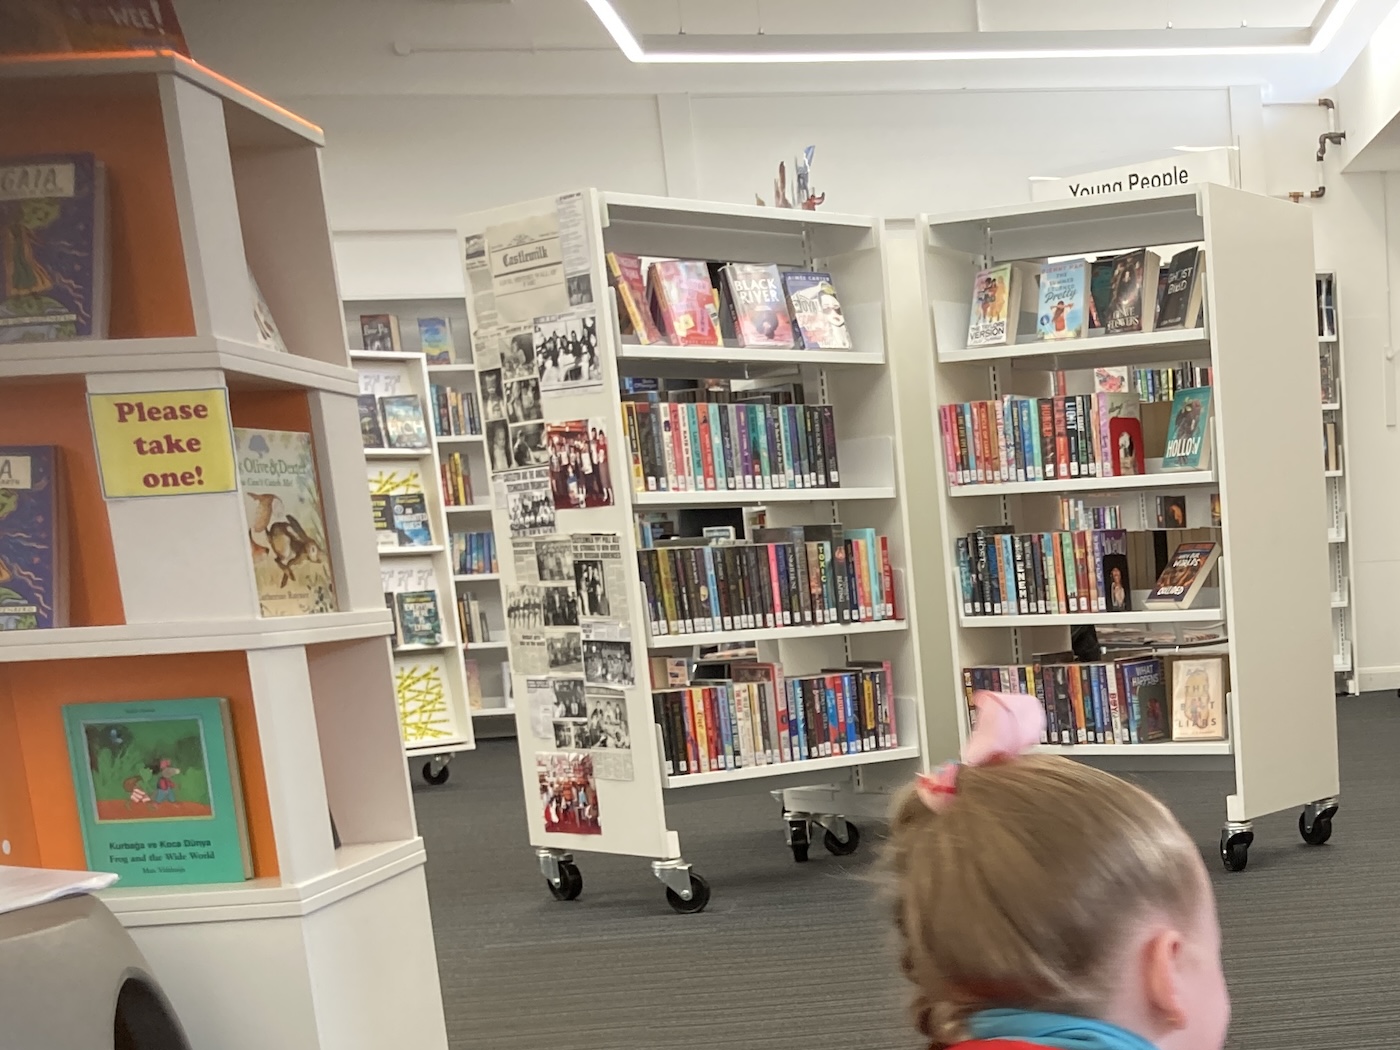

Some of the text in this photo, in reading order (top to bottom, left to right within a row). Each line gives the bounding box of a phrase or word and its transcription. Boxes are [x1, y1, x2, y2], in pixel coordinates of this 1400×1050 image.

[734, 278, 777, 292] BLACK
[740, 290, 779, 304] RIVER
[113, 401, 208, 423] Please
[1065, 402, 1078, 431] LIGHT
[133, 434, 201, 456] take
[142, 466, 205, 488] one!
[818, 546, 827, 583] TOXIC
[109, 855, 128, 863] Frog
[149, 853, 162, 861] the
[165, 852, 187, 861] Wide
[189, 851, 215, 859] World
